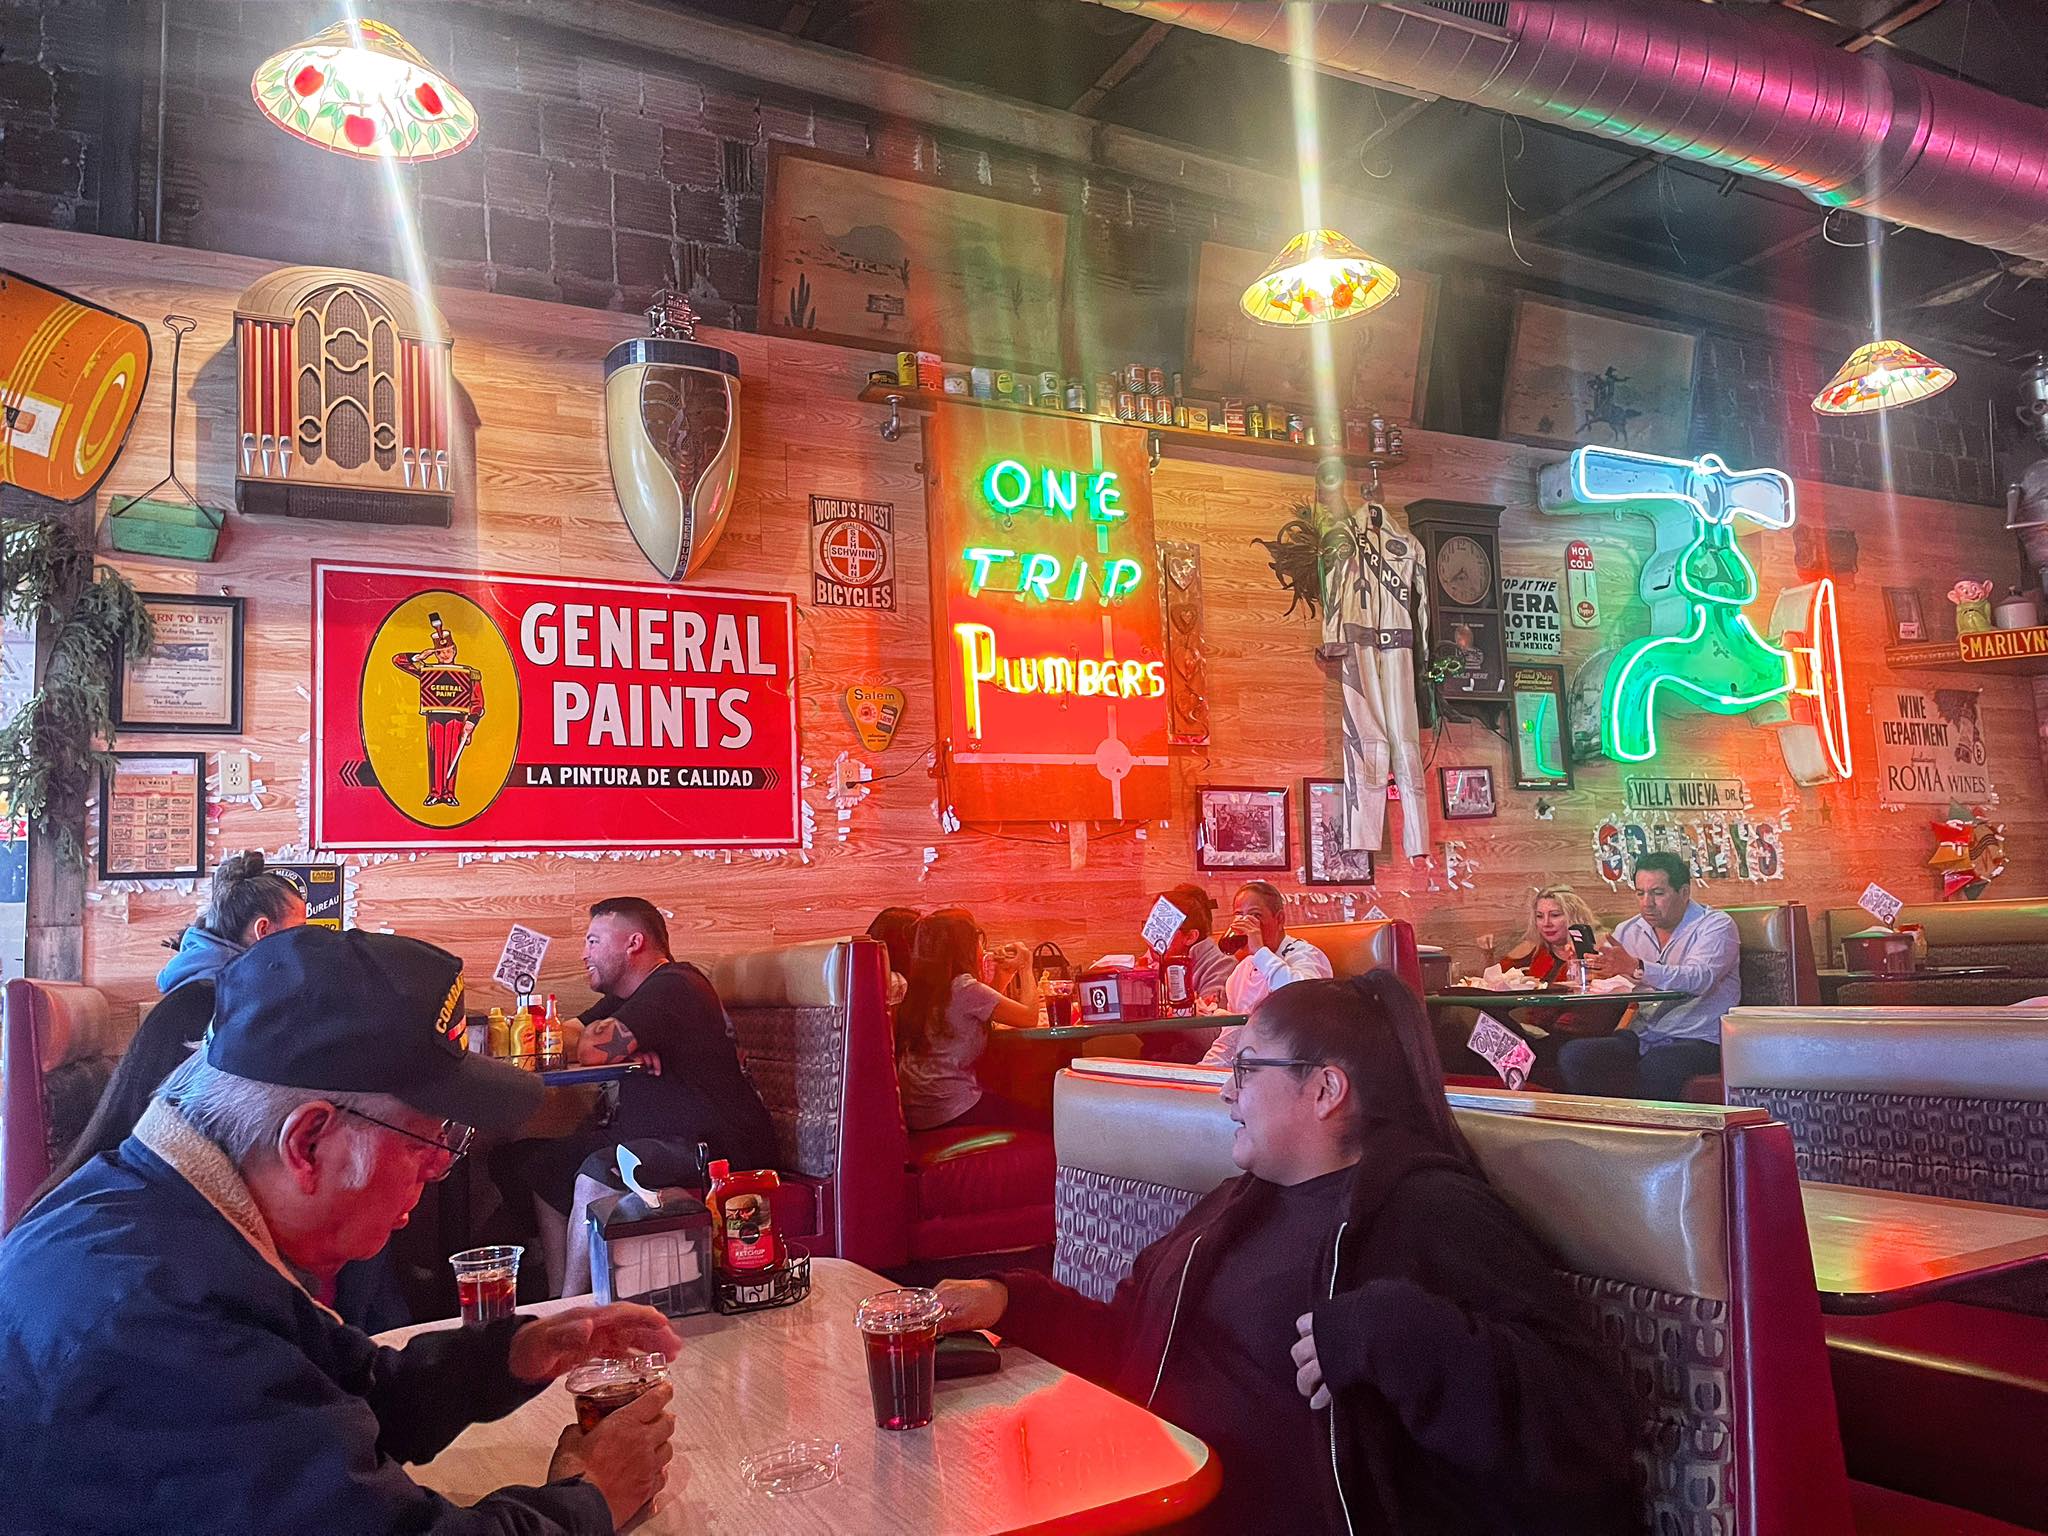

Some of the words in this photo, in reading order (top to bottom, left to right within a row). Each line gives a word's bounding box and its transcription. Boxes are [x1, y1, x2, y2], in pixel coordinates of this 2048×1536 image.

[985, 460, 1127, 521] ONE
[814, 499, 857, 523] WORLD'S
[858, 503, 890, 531] FINEST
[831, 547, 876, 559] SCHWINN
[1571, 546, 1590, 557] HOT
[962, 547, 1142, 606] TRIP
[1570, 560, 1594, 569] COLD
[816, 578, 892, 609] BICYCLES
[1519, 580, 1534, 591] AT
[1534, 581, 1557, 592] THE
[177, 614, 194, 624] TO
[198, 616, 224, 625] FLY!
[520, 601, 778, 676] GENERAL
[1504, 630, 1515, 640] OT
[1520, 631, 1561, 642] SPRINGS
[1523, 642, 1553, 650] MEXICO
[1970, 630, 2048, 659] MARILYN
[430, 684, 464, 692] GENERAL
[953, 622, 1166, 741] PLUMBERS
[854, 688, 895, 701] Salem
[1897, 694, 1927, 719] WINE
[552, 680, 753, 750] PAINTS
[1883, 721, 1949, 747] DEPARTMENT
[526, 766, 553, 785] LA
[560, 766, 642, 786] PINTURA
[648, 767, 671, 786] DE
[677, 768, 754, 787] CALIDAD
[1888, 765, 1945, 792] ROMA
[1947, 775, 1986, 793] WINES
[1633, 781, 1673, 807] VILLA
[1679, 782, 1720, 807] NUEVA
[306, 895, 340, 918] BUREAU
[735, 1248, 766, 1258] KETCHUP
